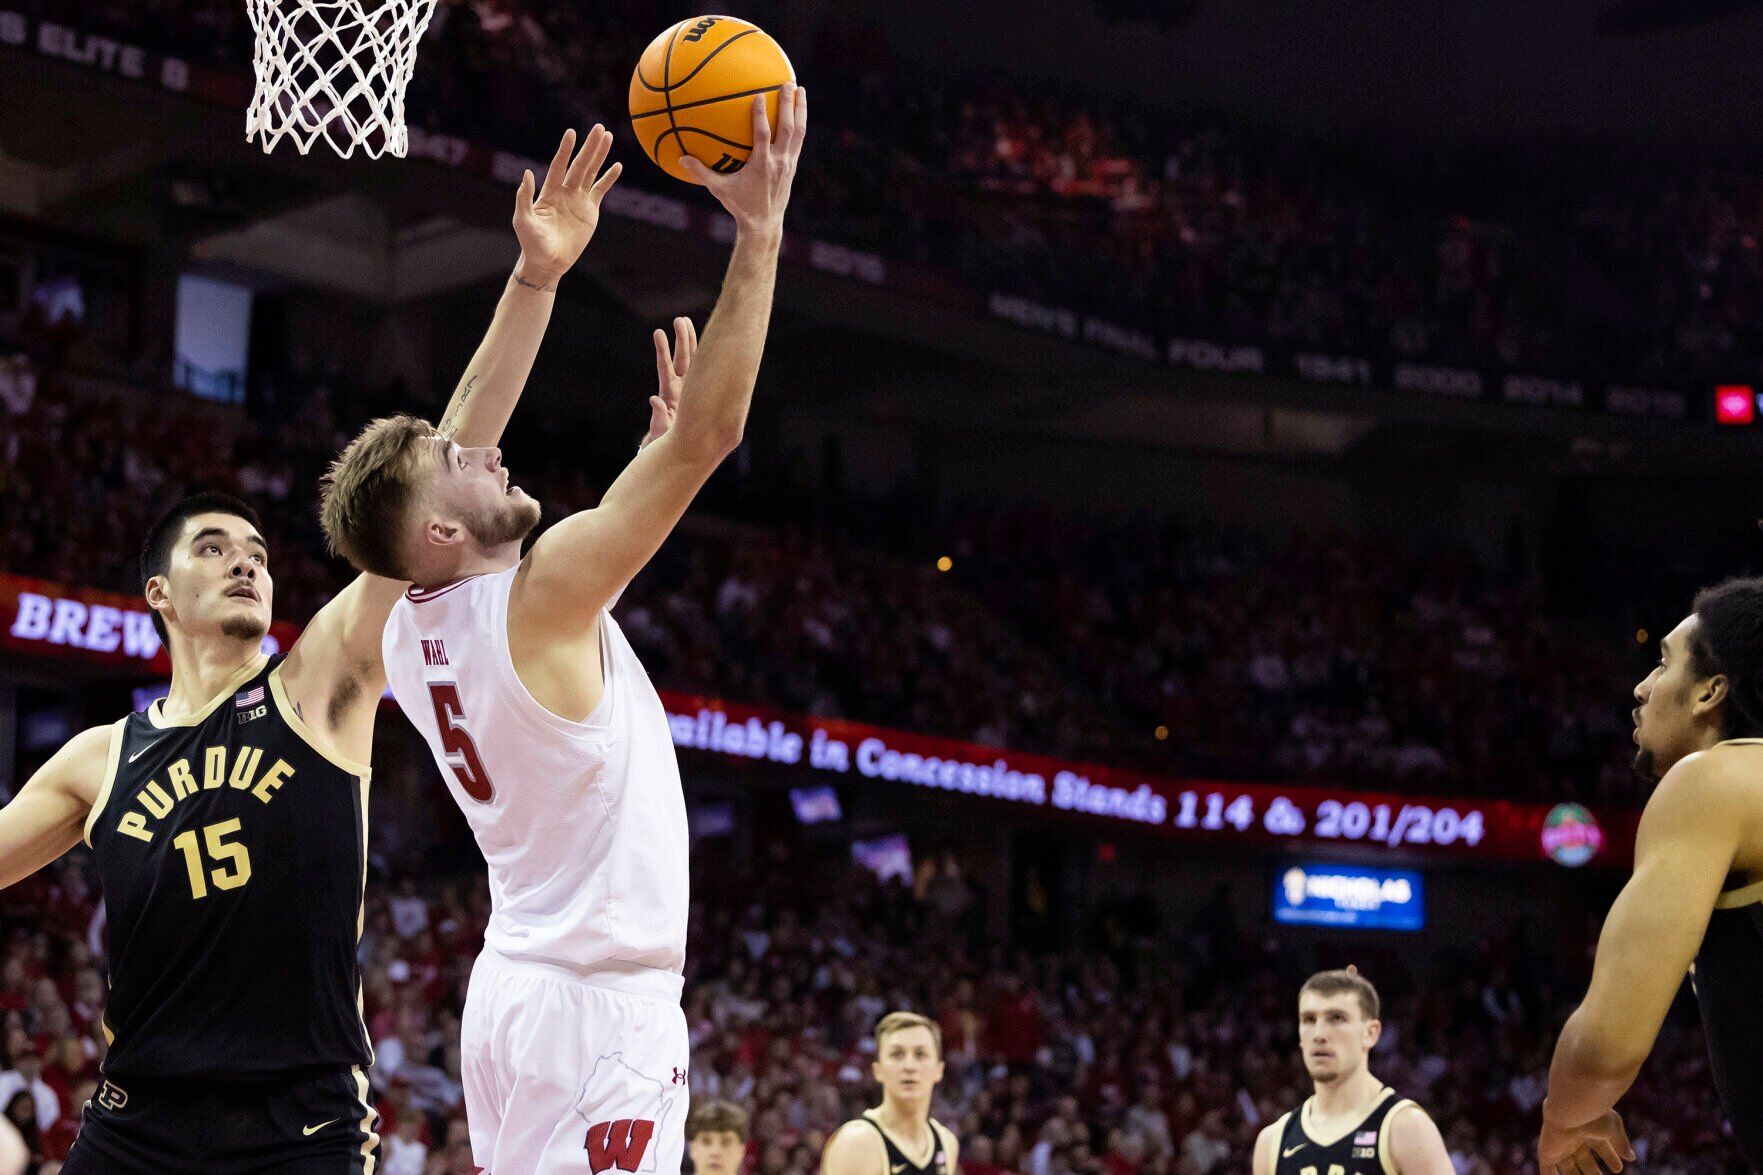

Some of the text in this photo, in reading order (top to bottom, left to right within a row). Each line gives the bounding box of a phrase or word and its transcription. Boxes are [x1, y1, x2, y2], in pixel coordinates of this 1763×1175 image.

[37, 20, 146, 80] ELITE
[1168, 337, 1264, 374] FOUR
[420, 639, 450, 666] WAHL
[427, 681, 496, 804] 5
[116, 745, 296, 843] PURDUE
[665, 708, 804, 765] ailable
[809, 727, 850, 773] in
[856, 738, 1047, 805] Concession
[1051, 770, 1168, 825] Stands
[1174, 790, 1256, 832] 114
[1263, 795, 1307, 837] &
[1313, 799, 1486, 849] 201/204
[173, 817, 252, 900] 15
[583, 1118, 655, 1175] W
